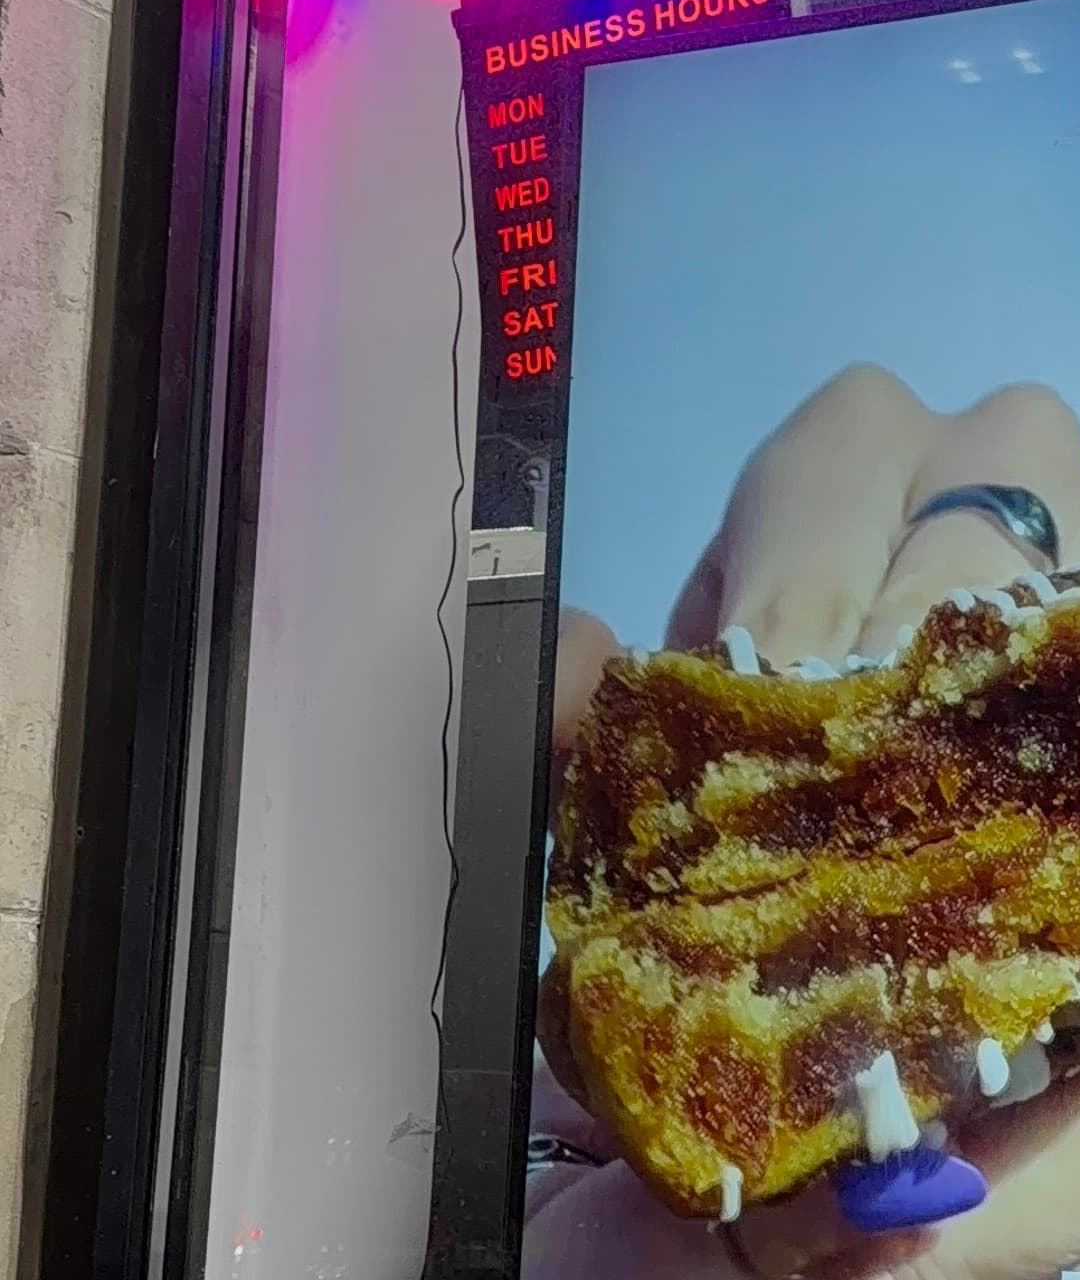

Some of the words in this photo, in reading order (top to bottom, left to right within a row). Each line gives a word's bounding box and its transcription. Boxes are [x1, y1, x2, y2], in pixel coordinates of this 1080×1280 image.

[485, 8, 646, 75] BUSINESS
[488, 92, 545, 128] MON
[492, 133, 548, 169] TUE
[495, 177, 551, 212] WED
[497, 218, 554, 255] THU
[501, 261, 558, 296] FRI
[504, 301, 559, 338] SAT
